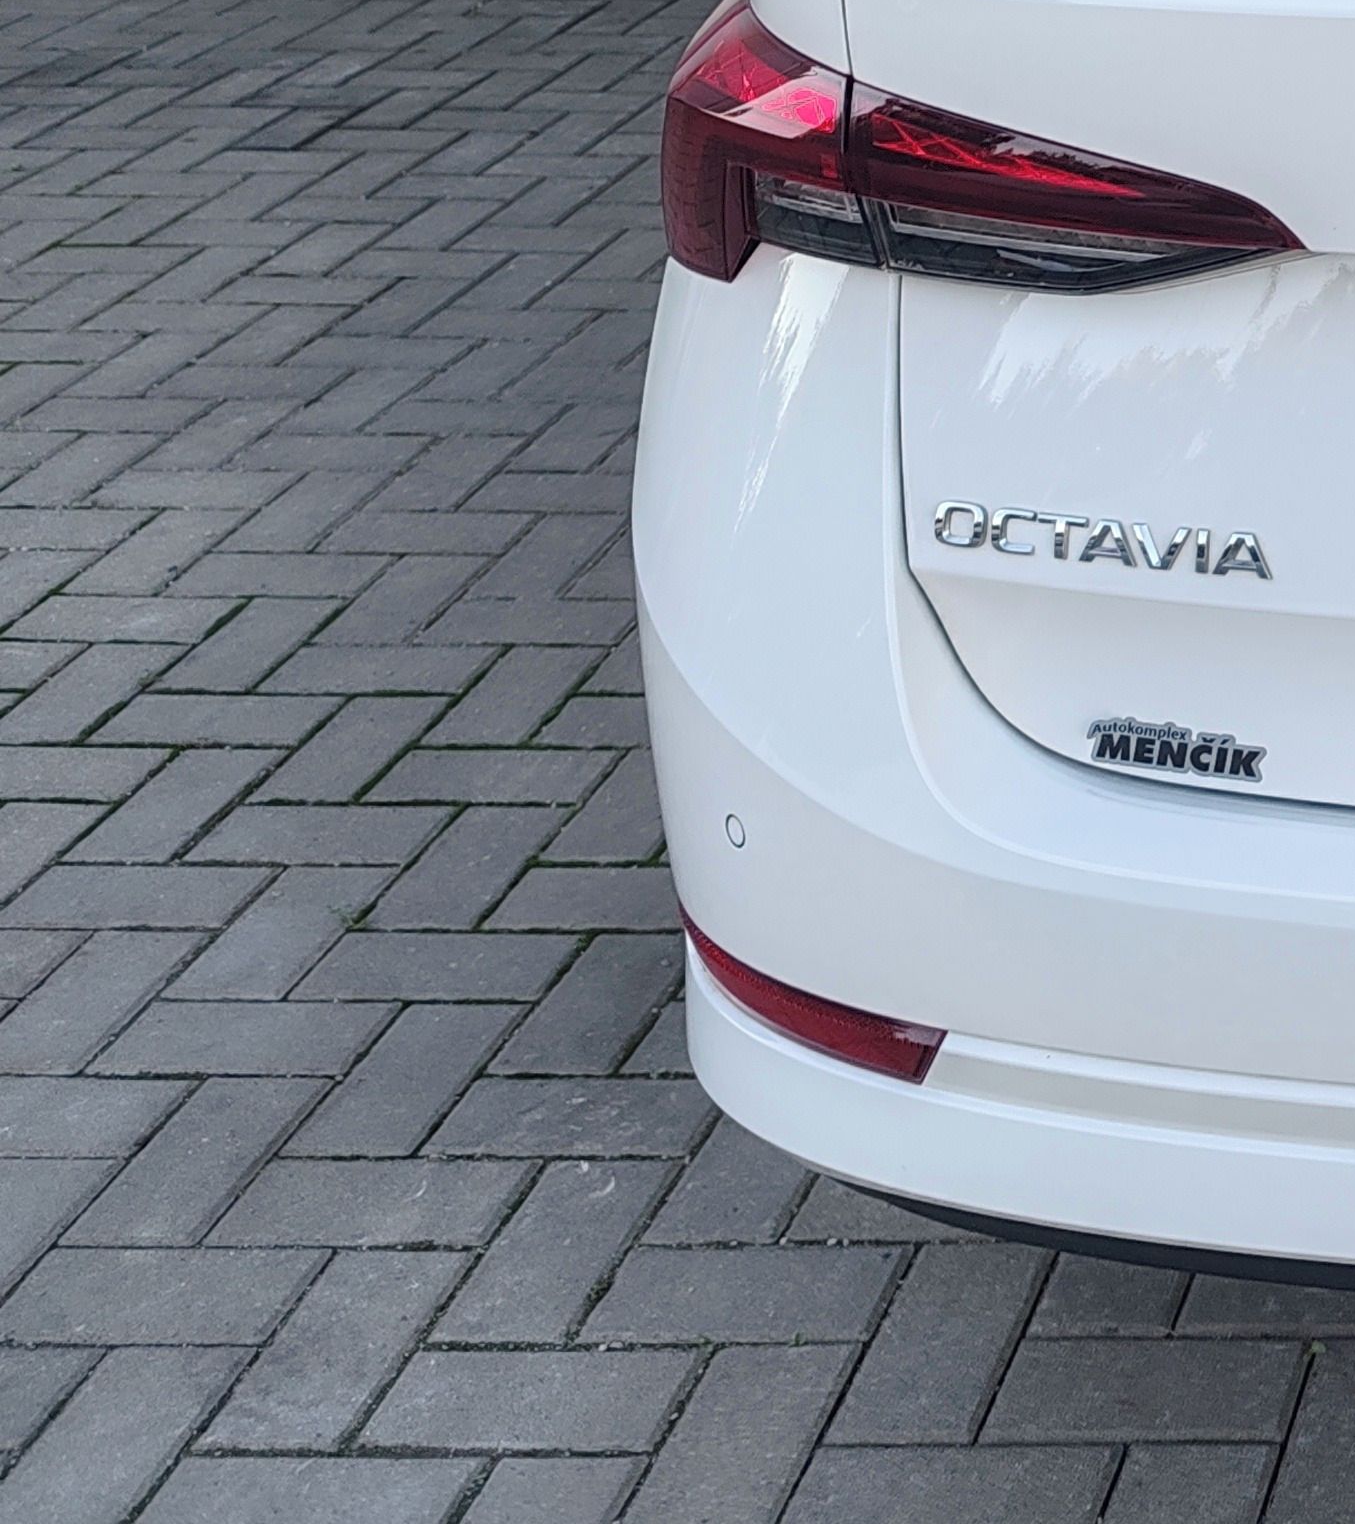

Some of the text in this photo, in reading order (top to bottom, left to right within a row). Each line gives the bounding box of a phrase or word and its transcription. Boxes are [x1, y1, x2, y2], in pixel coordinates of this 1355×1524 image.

[934, 500, 1274, 580] OCTAVIA
[1091, 721, 1188, 741] Autokomplex
[1095, 733, 1261, 778] MENČÍK
